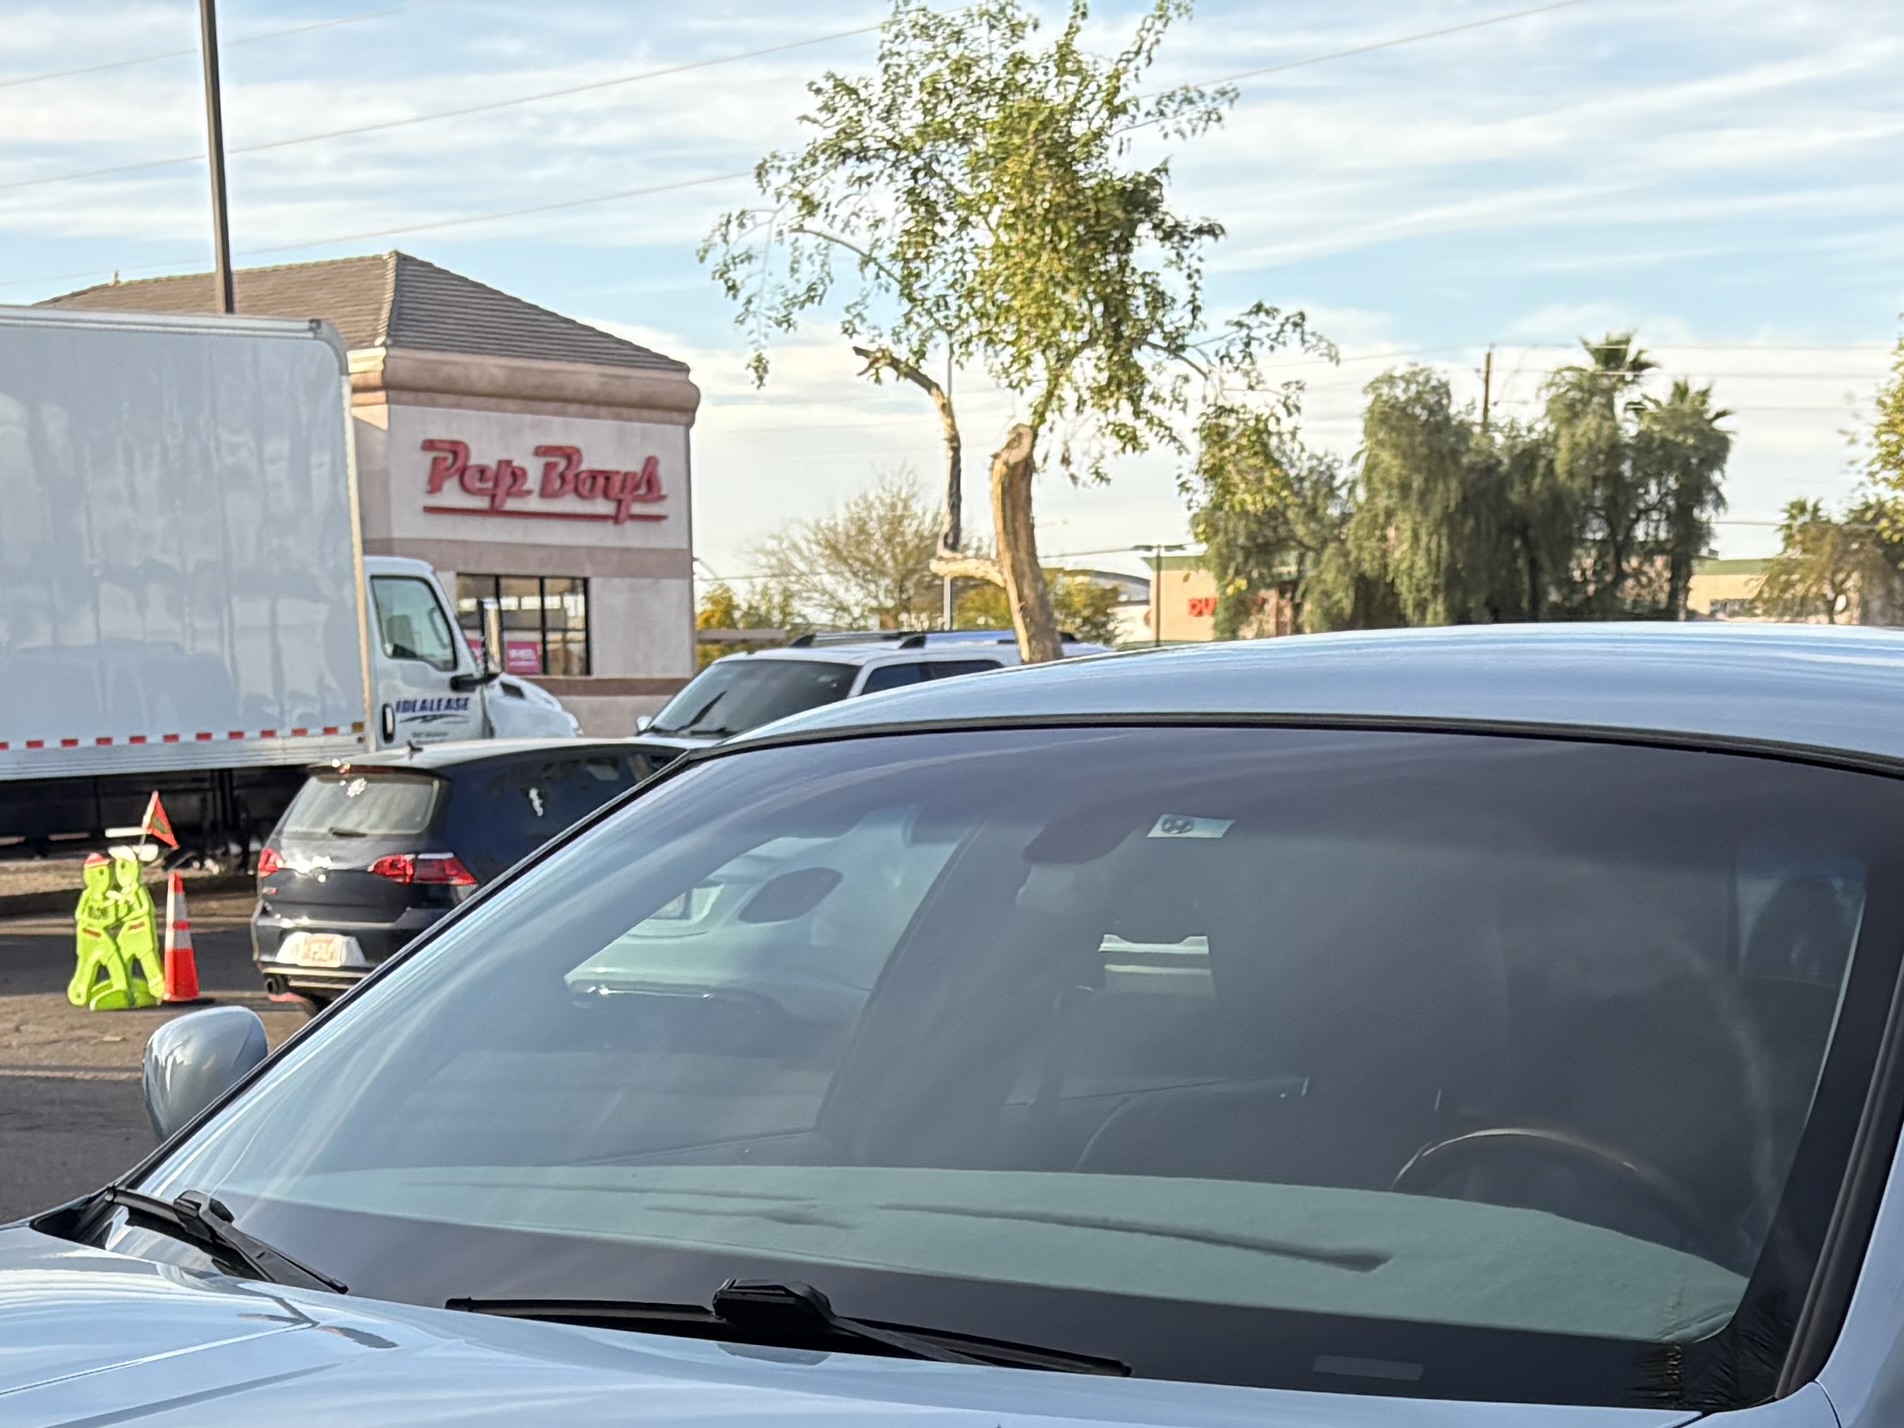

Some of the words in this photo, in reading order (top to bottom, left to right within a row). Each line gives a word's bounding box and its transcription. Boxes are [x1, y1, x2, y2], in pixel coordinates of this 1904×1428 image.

[420, 438, 533, 511] Pep
[533, 444, 668, 525] Boys
[396, 697, 470, 714] IDEALEASE
